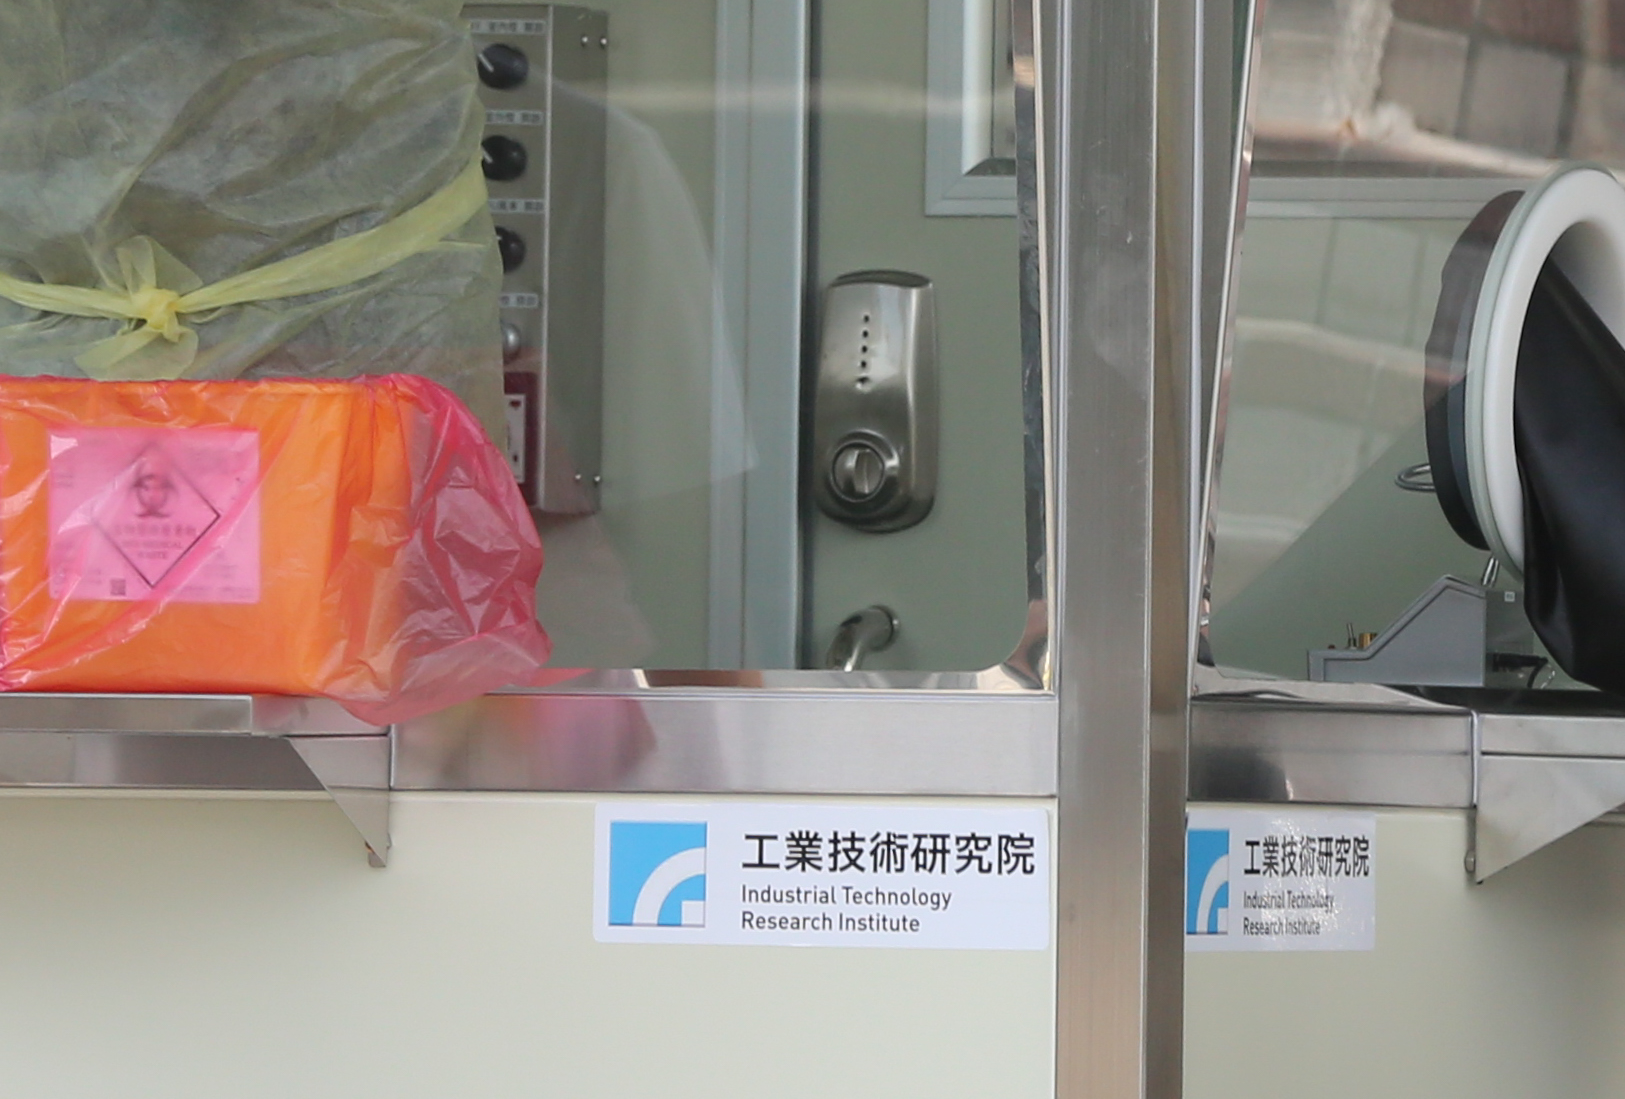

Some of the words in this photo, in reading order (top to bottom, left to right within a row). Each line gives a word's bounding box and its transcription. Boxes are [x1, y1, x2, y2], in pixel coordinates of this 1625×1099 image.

[741, 830, 1036, 876] 工業技術研究院
[1243, 834, 1370, 878] 工業技術研究院
[741, 883, 838, 905] Industrial
[841, 884, 953, 911] Technology
[741, 910, 834, 932] Research
[838, 911, 921, 934] Institute
[1242, 916, 1284, 936] Research
